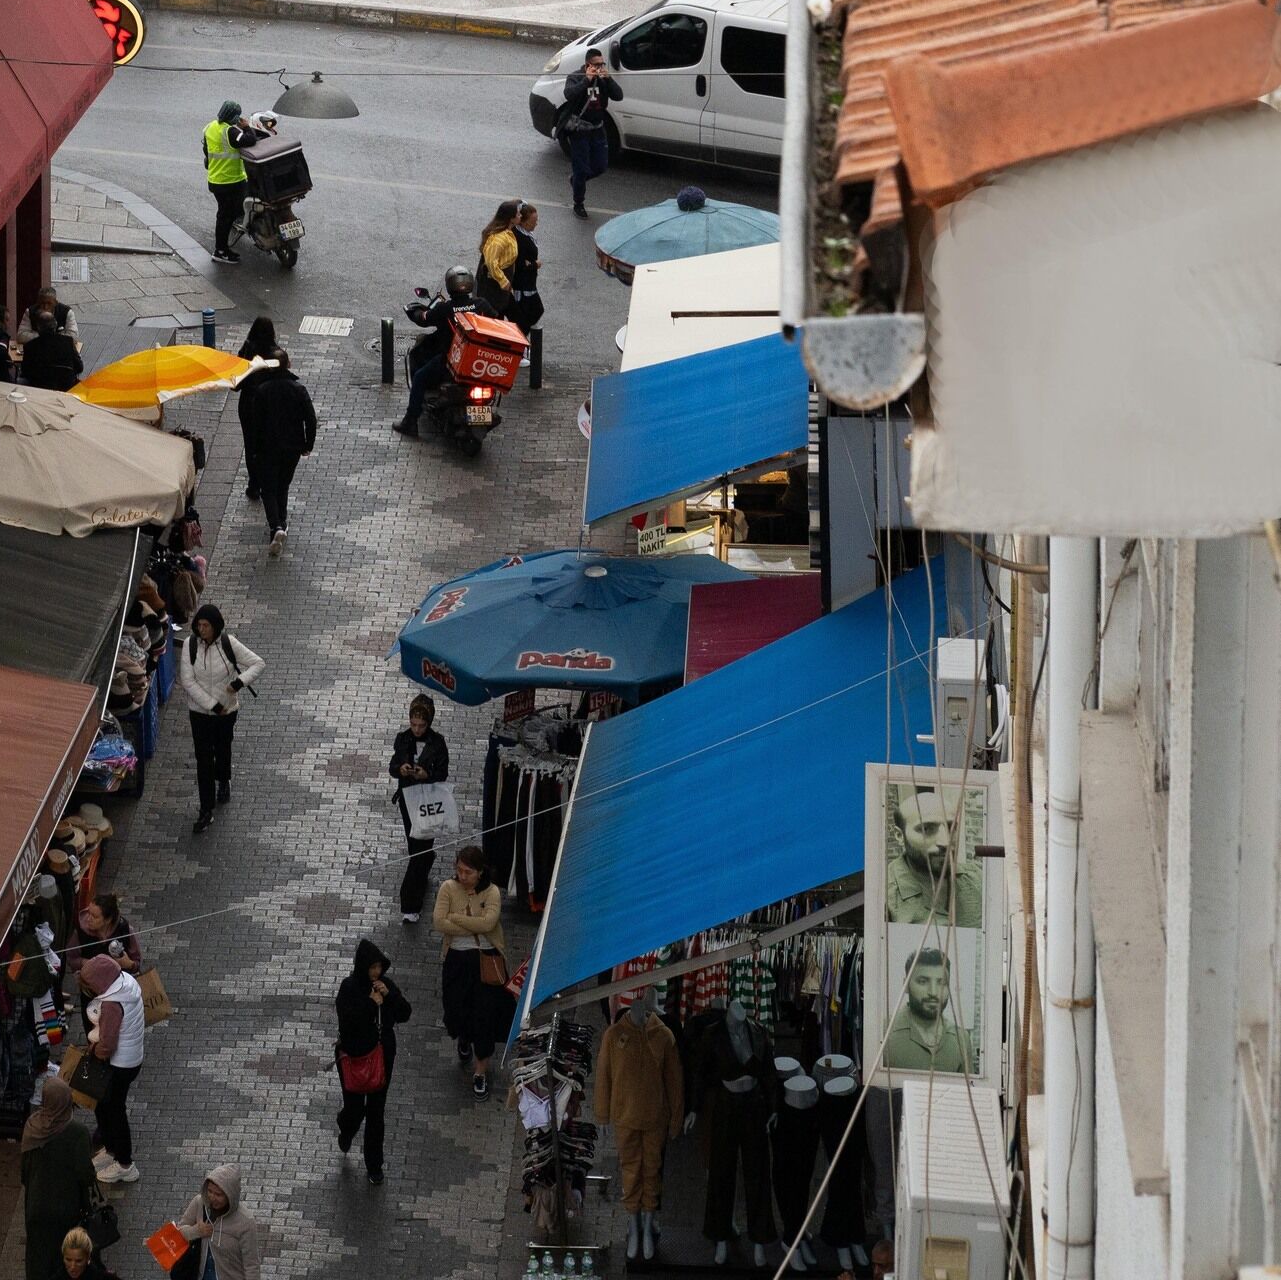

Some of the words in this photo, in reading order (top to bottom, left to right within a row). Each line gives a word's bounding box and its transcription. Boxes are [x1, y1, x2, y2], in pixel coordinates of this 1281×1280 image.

[587, 86, 600, 101] T
[477, 348, 513, 364] trendyol
[471, 358, 509, 378] go
[639, 530, 655, 544] 400
[656, 525, 666, 538] TL
[640, 538, 666, 555] NAKİT
[517, 648, 614, 670] panda
[422, 657, 456, 690] panda
[419, 801, 445, 817] SEZ
